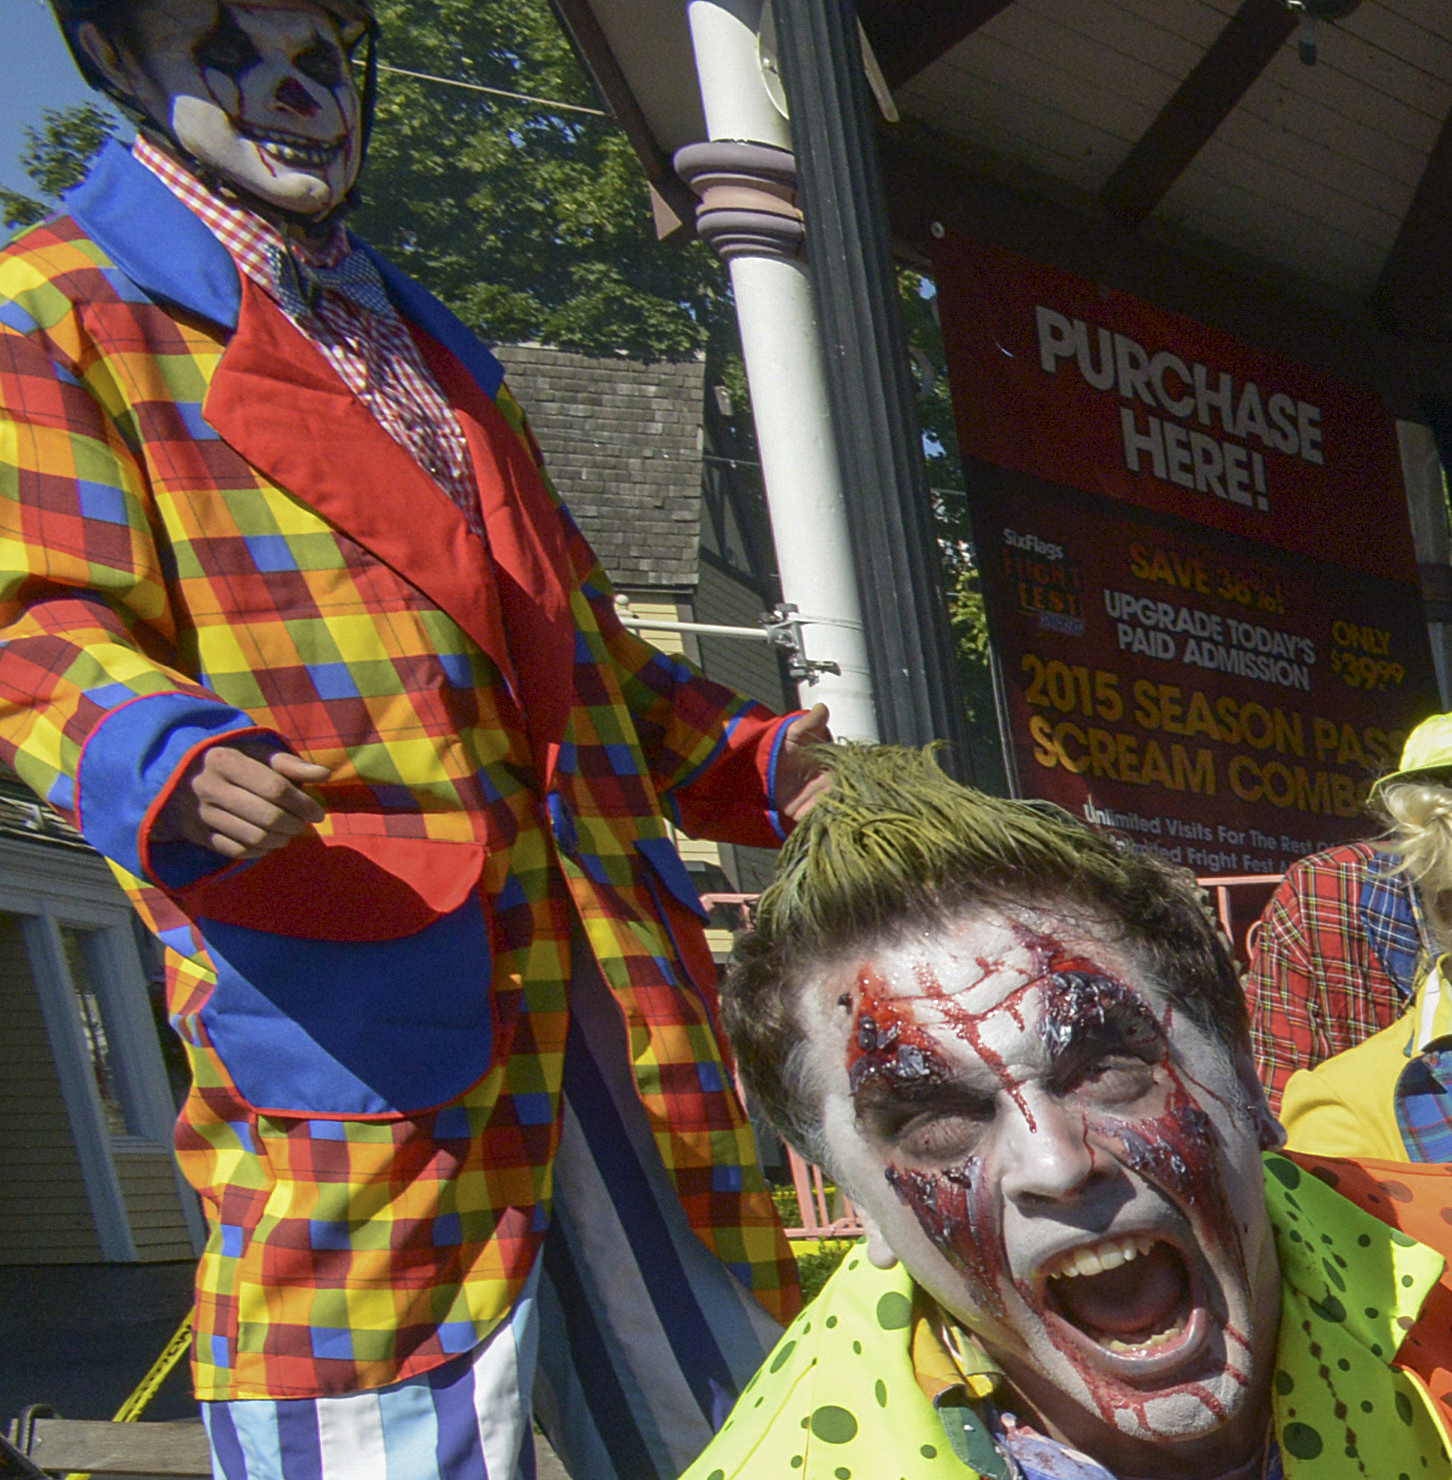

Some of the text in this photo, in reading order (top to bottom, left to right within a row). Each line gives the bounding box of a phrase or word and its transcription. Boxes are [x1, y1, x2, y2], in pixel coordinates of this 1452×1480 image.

[1036, 305, 1325, 465] PURCHASE
[1120, 406, 1269, 512] HERE!
[1003, 528, 1064, 560] SixFlags
[1129, 543, 1212, 596] SAVE
[1104, 588, 1223, 643] UPGRADE
[1225, 618, 1316, 664] TODAY'S
[1116, 623, 1176, 660] PAID
[1181, 638, 1310, 691] ADMISSION
[1331, 620, 1392, 656] ONLY
[1021, 654, 1126, 722] 2015
[1132, 679, 1307, 757] SEASON
[1029, 714, 1215, 796] SCREAM
[1083, 802, 1160, 834] Unlimited
[1165, 817, 1213, 842] Visits
[1218, 826, 1246, 844] For
[1249, 830, 1277, 850] The
[1281, 835, 1319, 855] Rest
[1187, 848, 1239, 872] Fright
[1243, 855, 1273, 873] Fest
